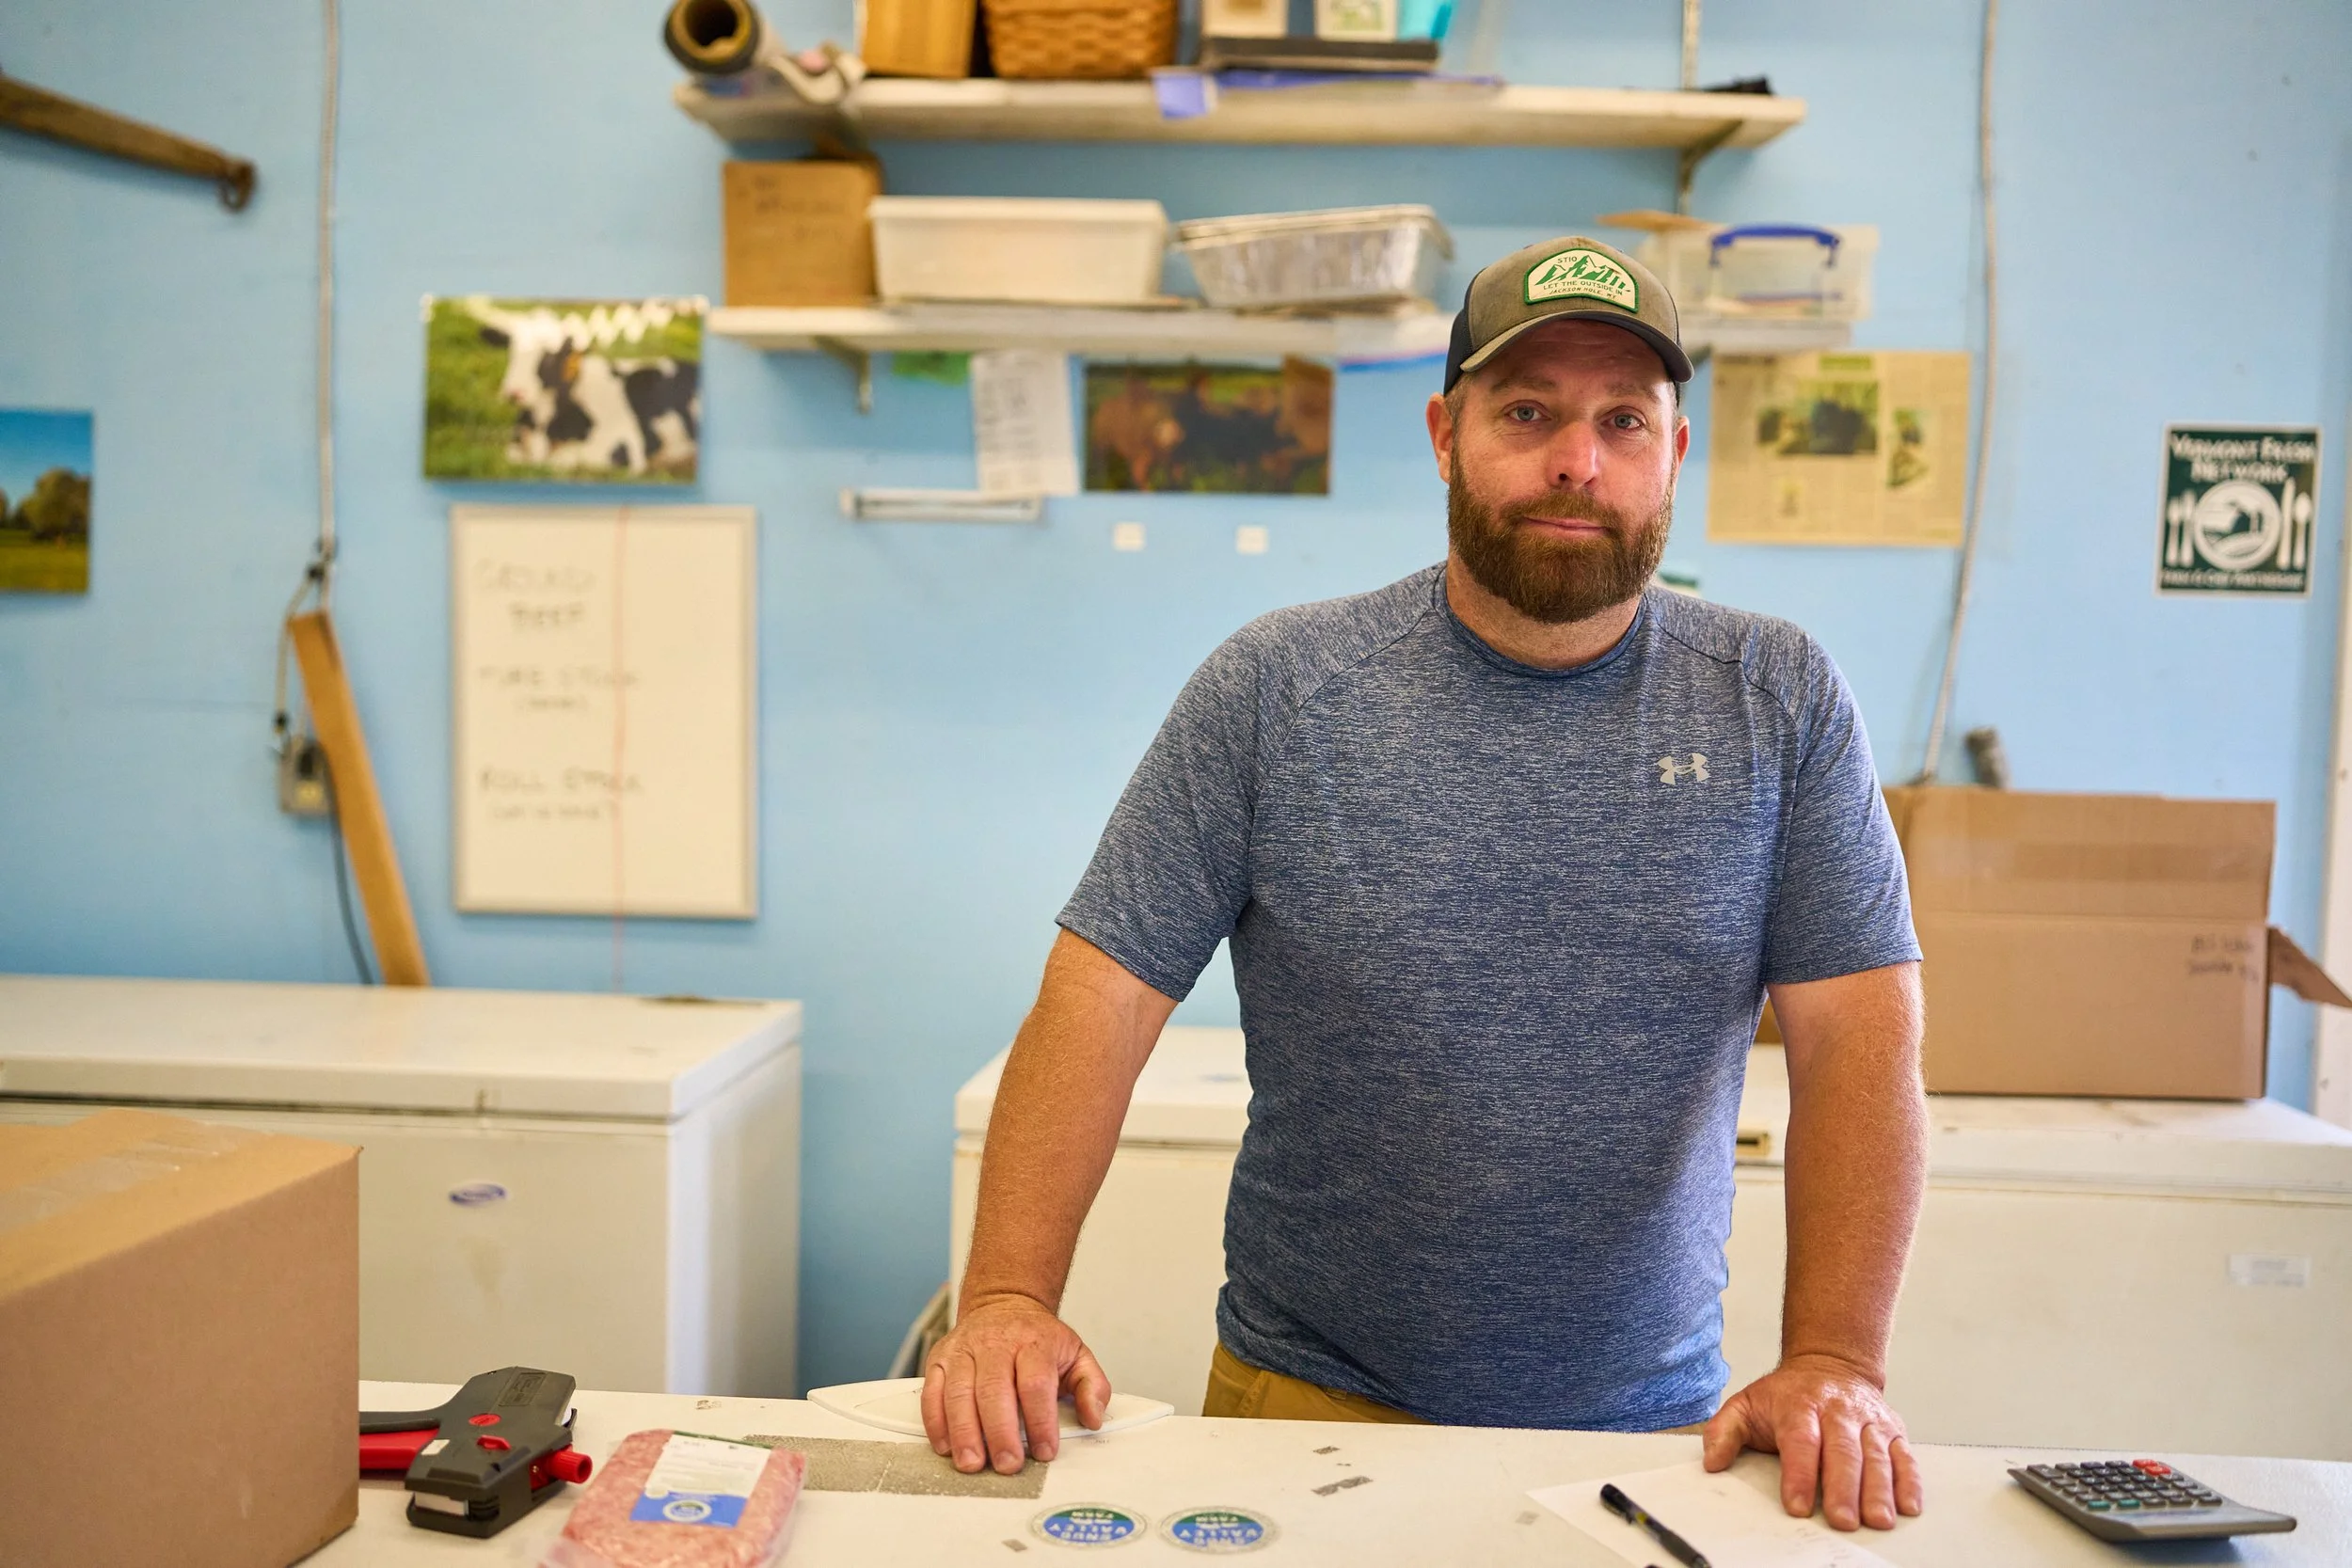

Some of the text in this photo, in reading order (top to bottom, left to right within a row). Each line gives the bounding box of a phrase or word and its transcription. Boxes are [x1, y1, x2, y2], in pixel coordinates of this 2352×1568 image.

[1558, 256, 1578, 264] STIO
[1543, 282, 1559, 291] LET
[1581, 280, 1613, 293] OUTSIDE
[1549, 286, 1581, 295] JACKSON
[1072, 1511, 1114, 1519] FARM
[1048, 1523, 1128, 1536] VALLEY
[1180, 1528, 1258, 1538] VALLEY
